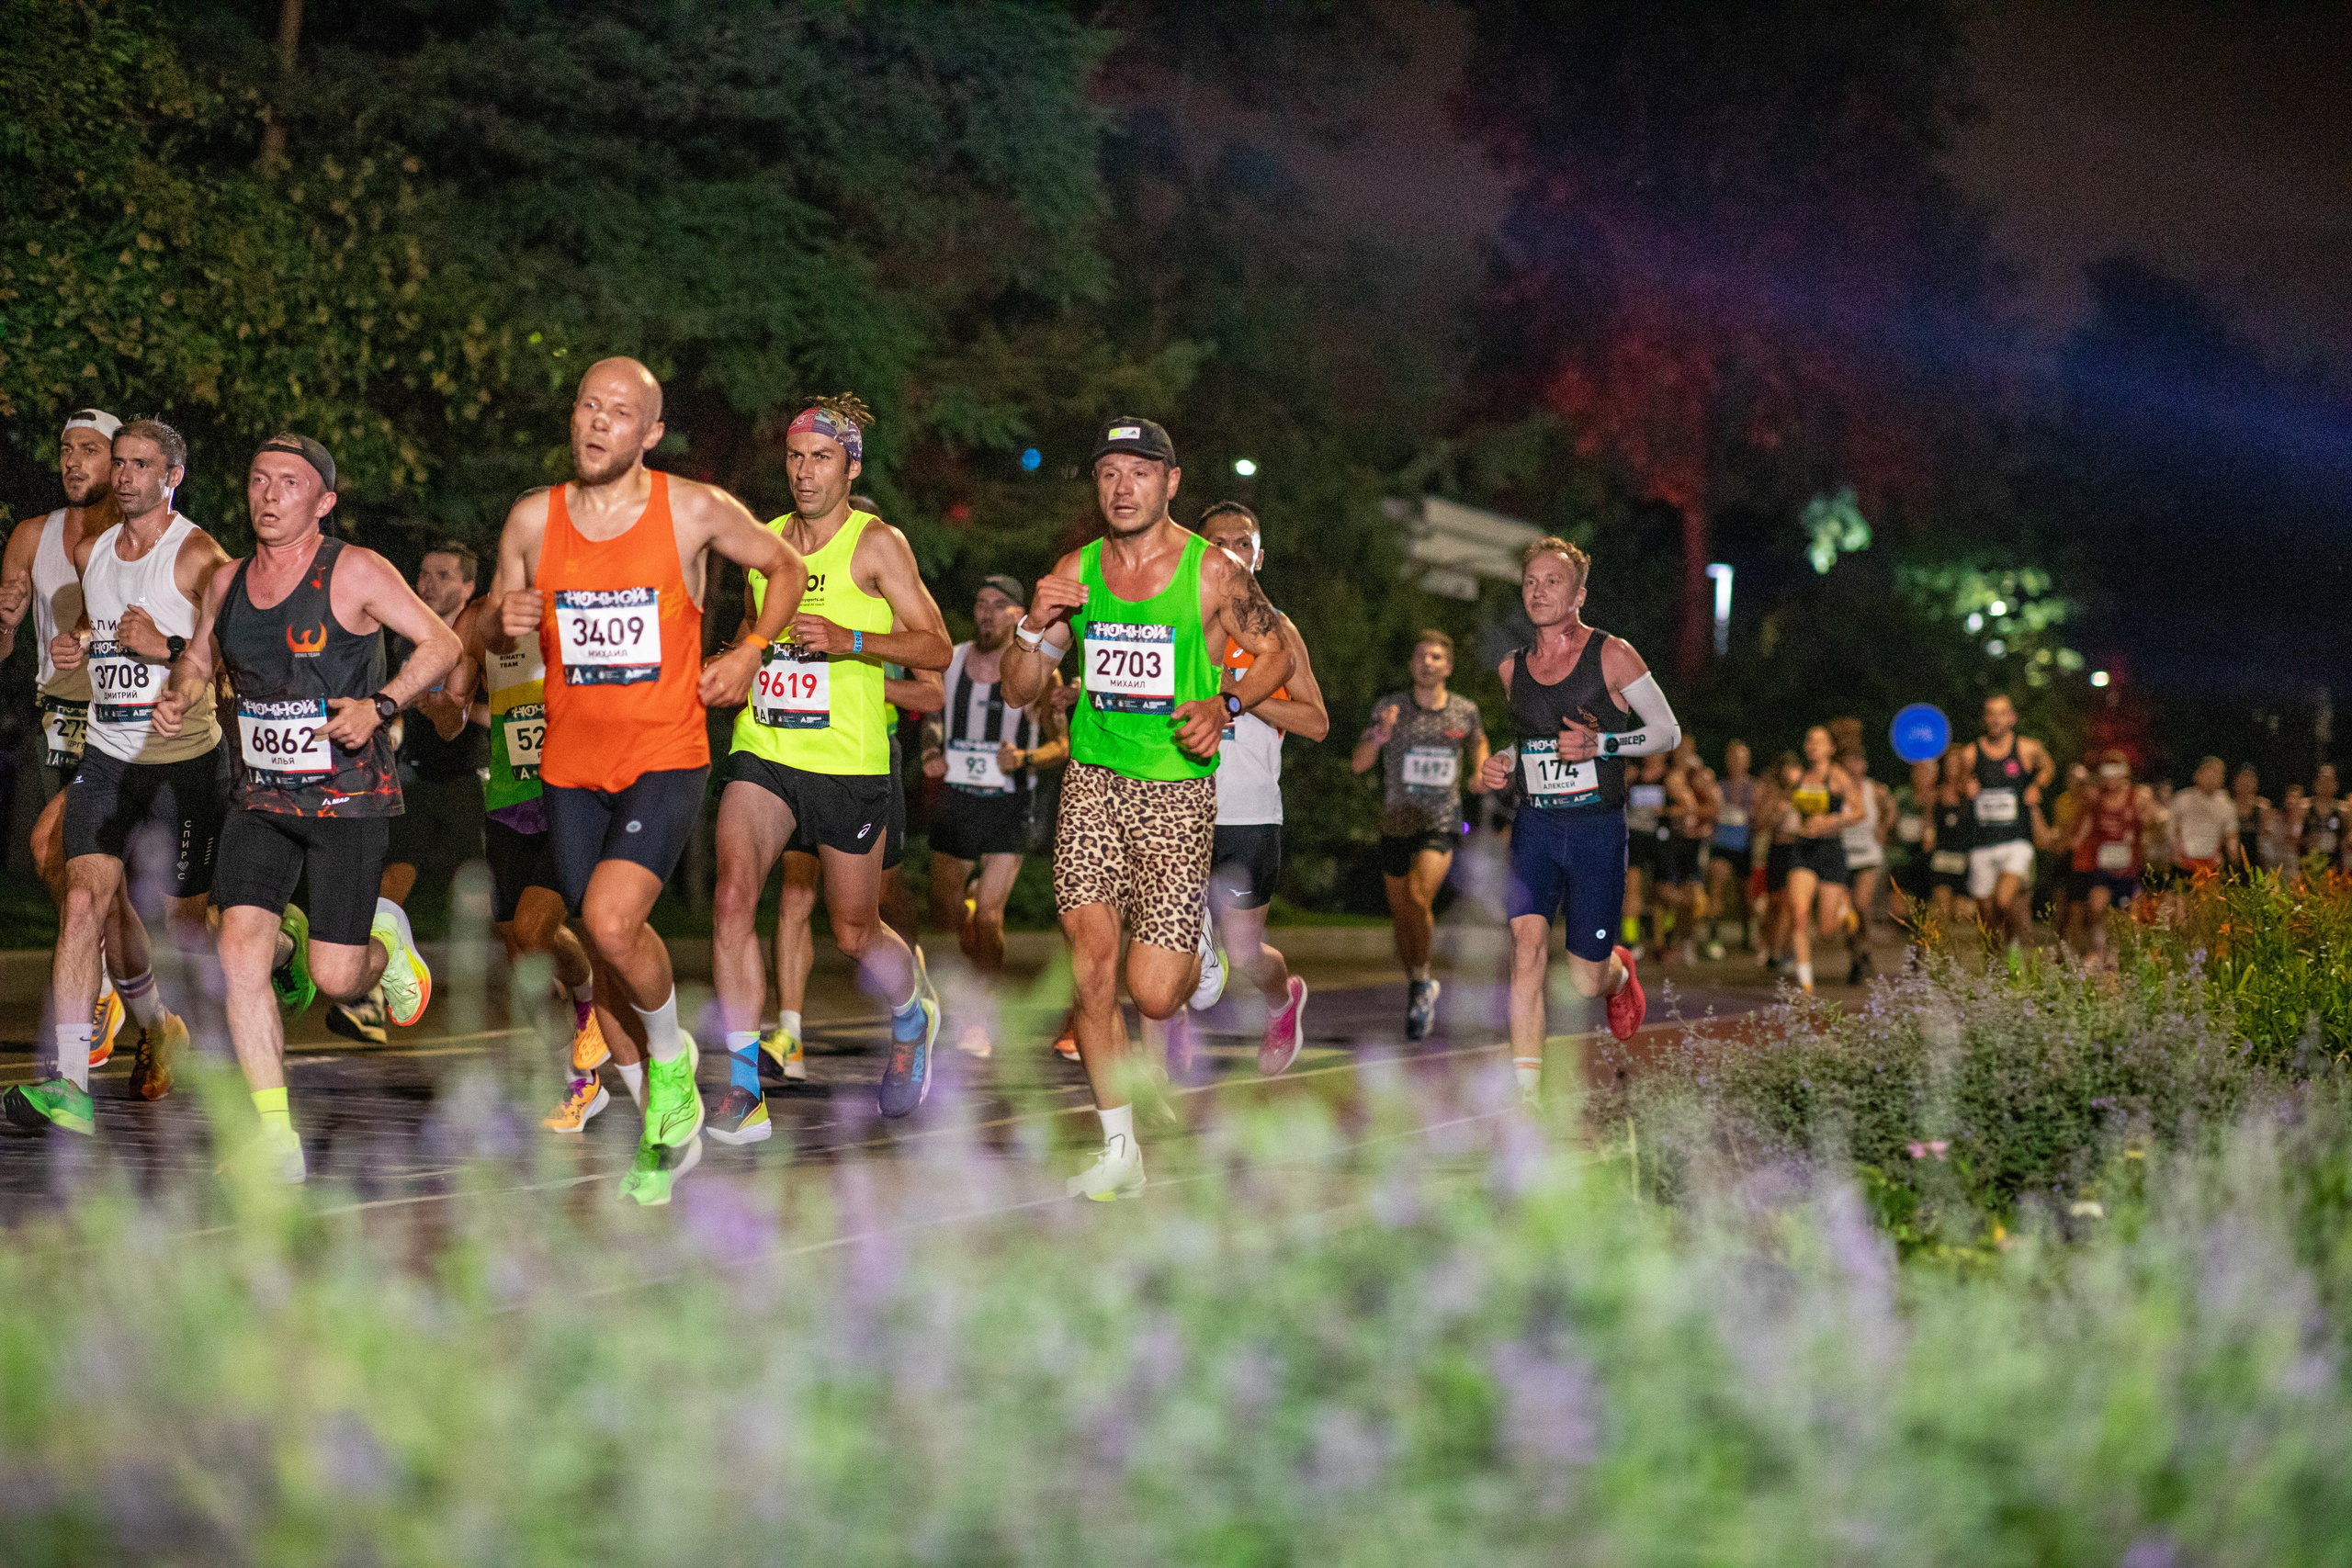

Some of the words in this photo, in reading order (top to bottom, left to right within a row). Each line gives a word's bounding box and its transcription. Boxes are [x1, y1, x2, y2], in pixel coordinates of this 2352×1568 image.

[564, 587, 649, 606] НОЧНОЙ
[572, 616, 645, 647] 3409
[1093, 622, 1168, 639] НОЧНОЙ
[588, 649, 628, 659] МИХАИЛ
[1096, 649, 1162, 679] 2703
[95, 663, 150, 690] 3708
[758, 671, 818, 699] 9619
[1110, 679, 1146, 689] МИХАИЛ
[104, 690, 138, 700] ДМИТРИЙ
[243, 698, 319, 717] НОЧНОЙ
[252, 725, 319, 755] 6862
[271, 756, 296, 765] ИЛЬЯ
[966, 757, 987, 774] 93
[1538, 759, 1579, 782] 174
[1544, 780, 1576, 790] АЛЕКСЕЙ
